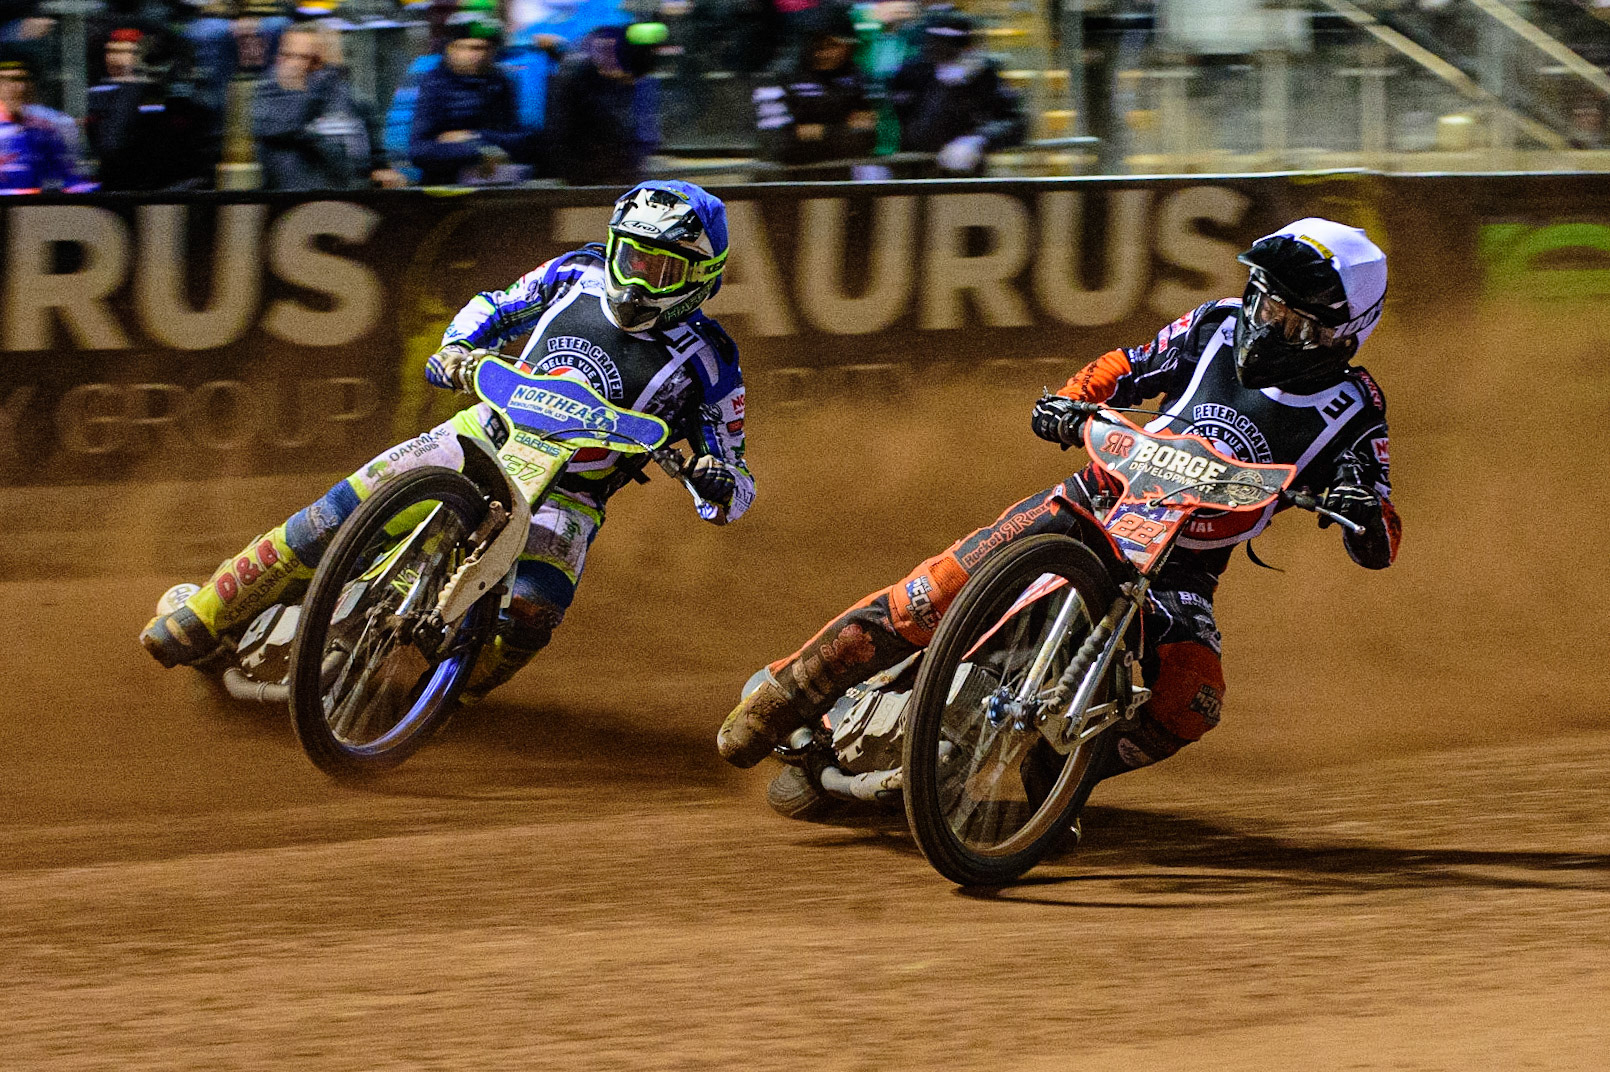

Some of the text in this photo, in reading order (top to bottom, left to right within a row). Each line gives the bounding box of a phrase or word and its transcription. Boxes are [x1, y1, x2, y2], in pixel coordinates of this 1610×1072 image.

[626, 221, 657, 235] Arai
[542, 357, 574, 371] BELLE
[578, 360, 597, 379] VUE
[547, 336, 624, 399] PETER CRAVEN
[510, 400, 569, 421] DEMOLITION UK LTD
[513, 387, 610, 428] NORTHEAST
[514, 432, 561, 457] HARRIS
[1193, 403, 1273, 463] PETER CRAVE
[1223, 431, 1244, 453] VUE
[502, 453, 546, 482] 37
[1134, 440, 1228, 482] BORGE
[1129, 461, 1215, 494] DEVELOPMENT
[1108, 512, 1167, 547] 22
